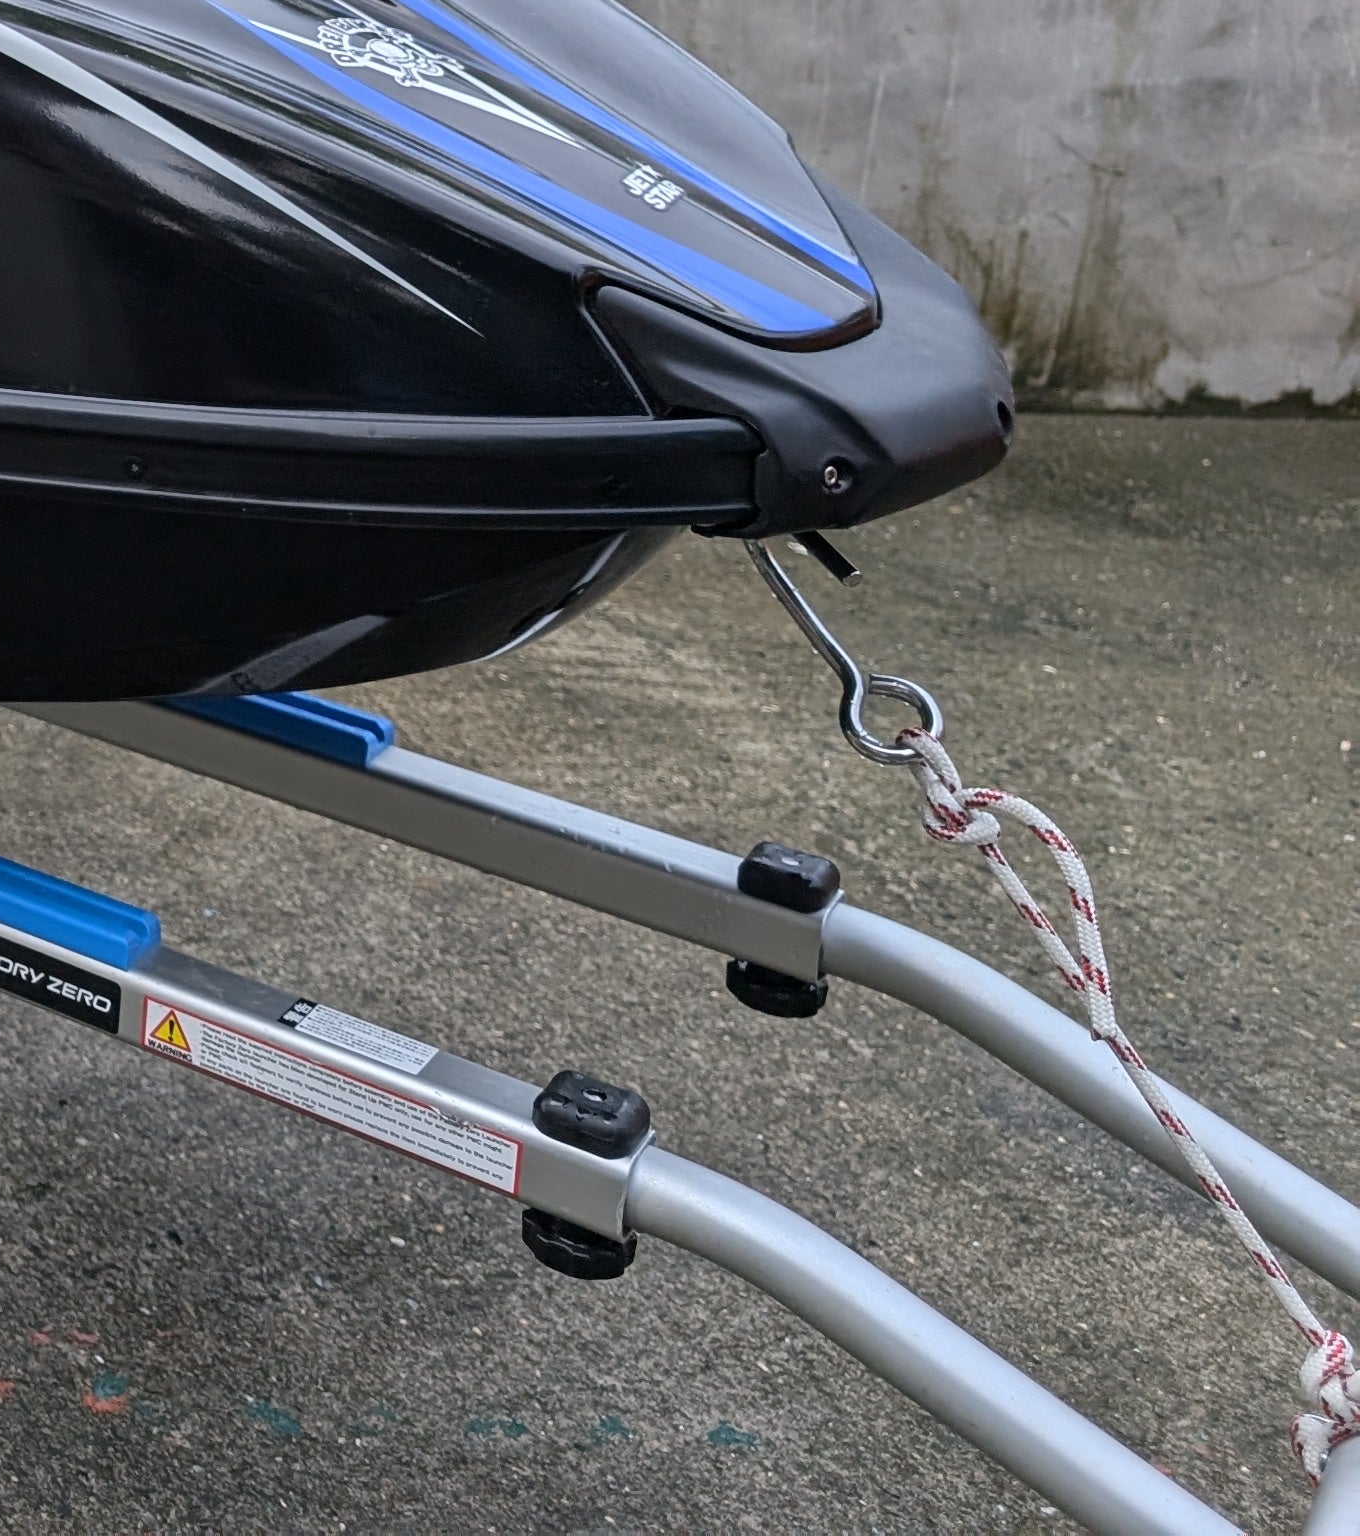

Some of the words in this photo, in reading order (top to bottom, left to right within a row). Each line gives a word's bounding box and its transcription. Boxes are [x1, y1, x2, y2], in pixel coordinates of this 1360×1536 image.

[622, 168, 656, 196] JET
[643, 179, 685, 210] STAR
[46, 975, 112, 1013] ZERO
[148, 1038, 193, 1063] WARNING
